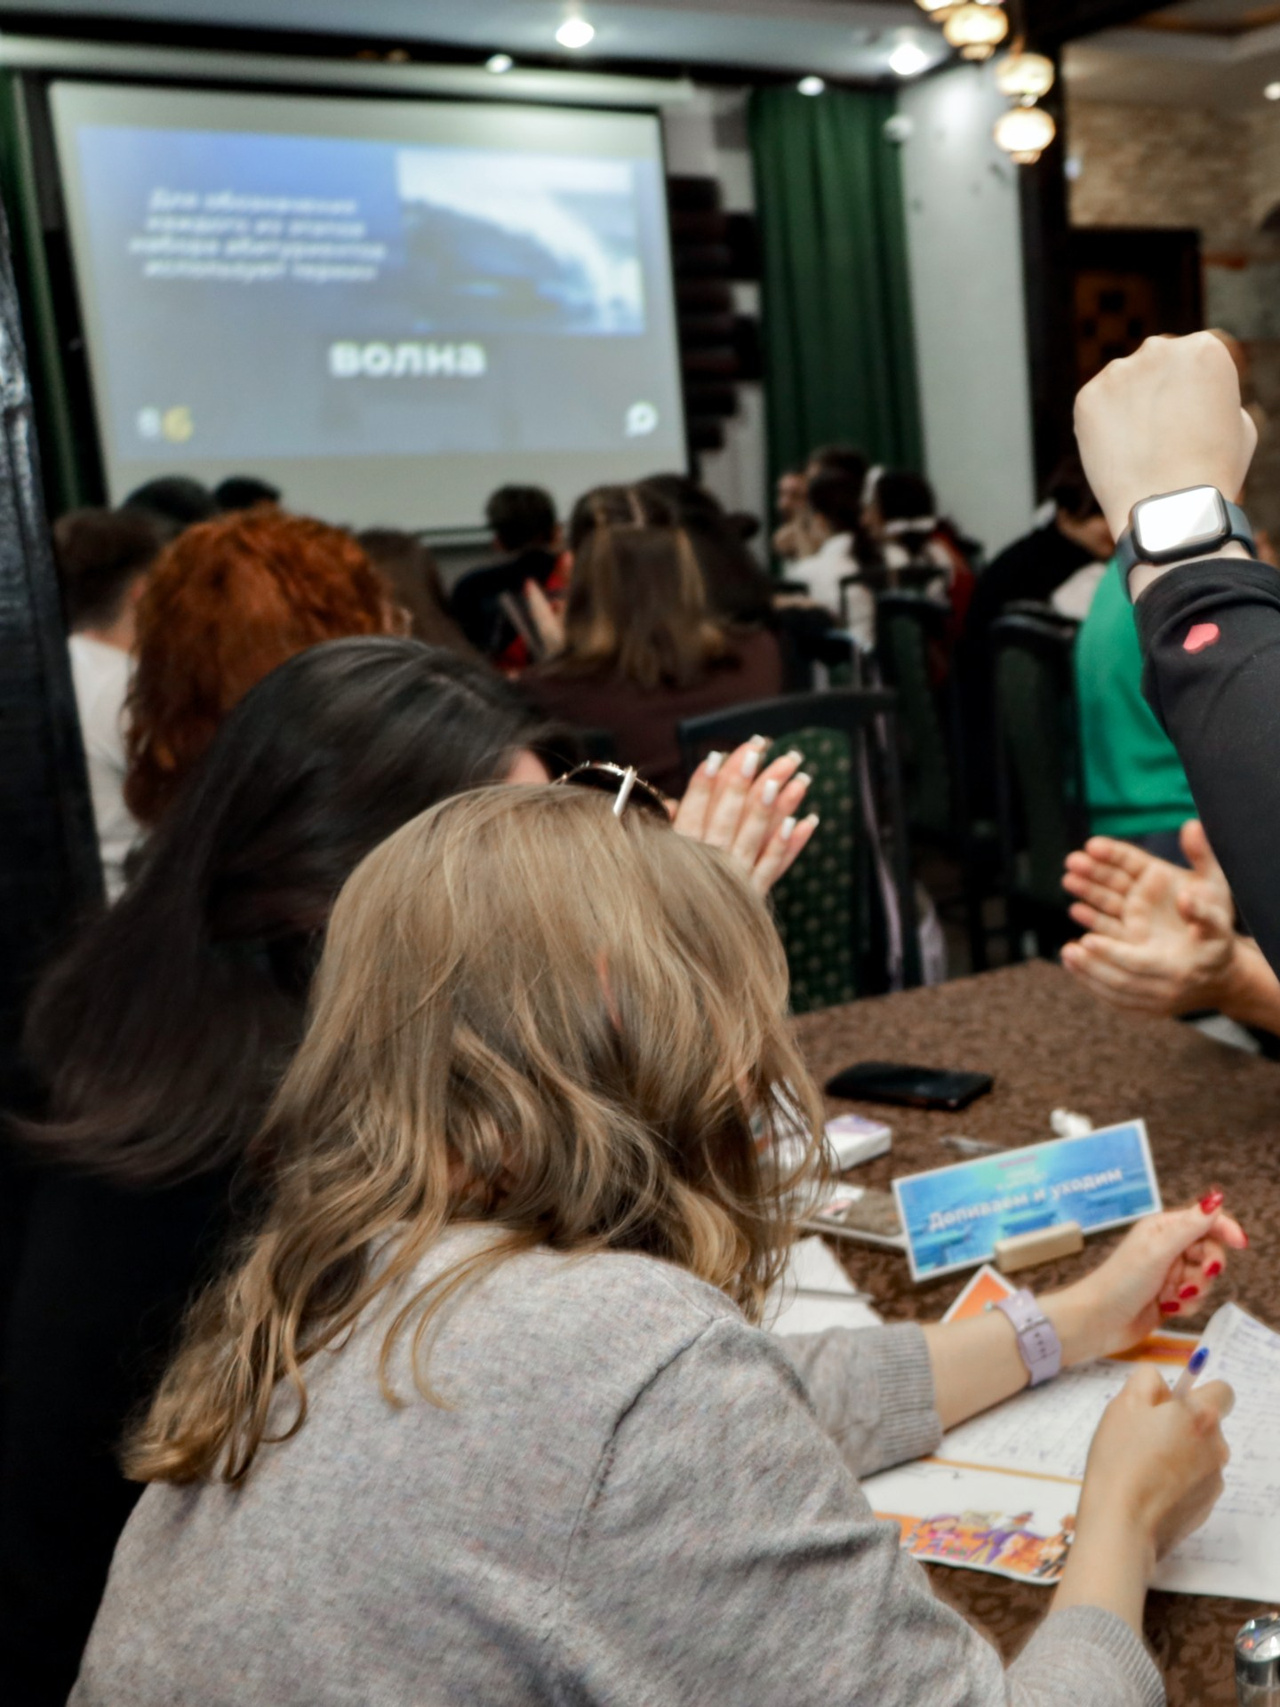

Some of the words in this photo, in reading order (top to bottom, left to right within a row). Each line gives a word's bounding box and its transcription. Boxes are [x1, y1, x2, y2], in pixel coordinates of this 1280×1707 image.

[331, 342, 486, 377] волна
[929, 1194, 1029, 1232] Допиваем
[1033, 1187, 1046, 1201] и
[1051, 1167, 1123, 1202] уходим
